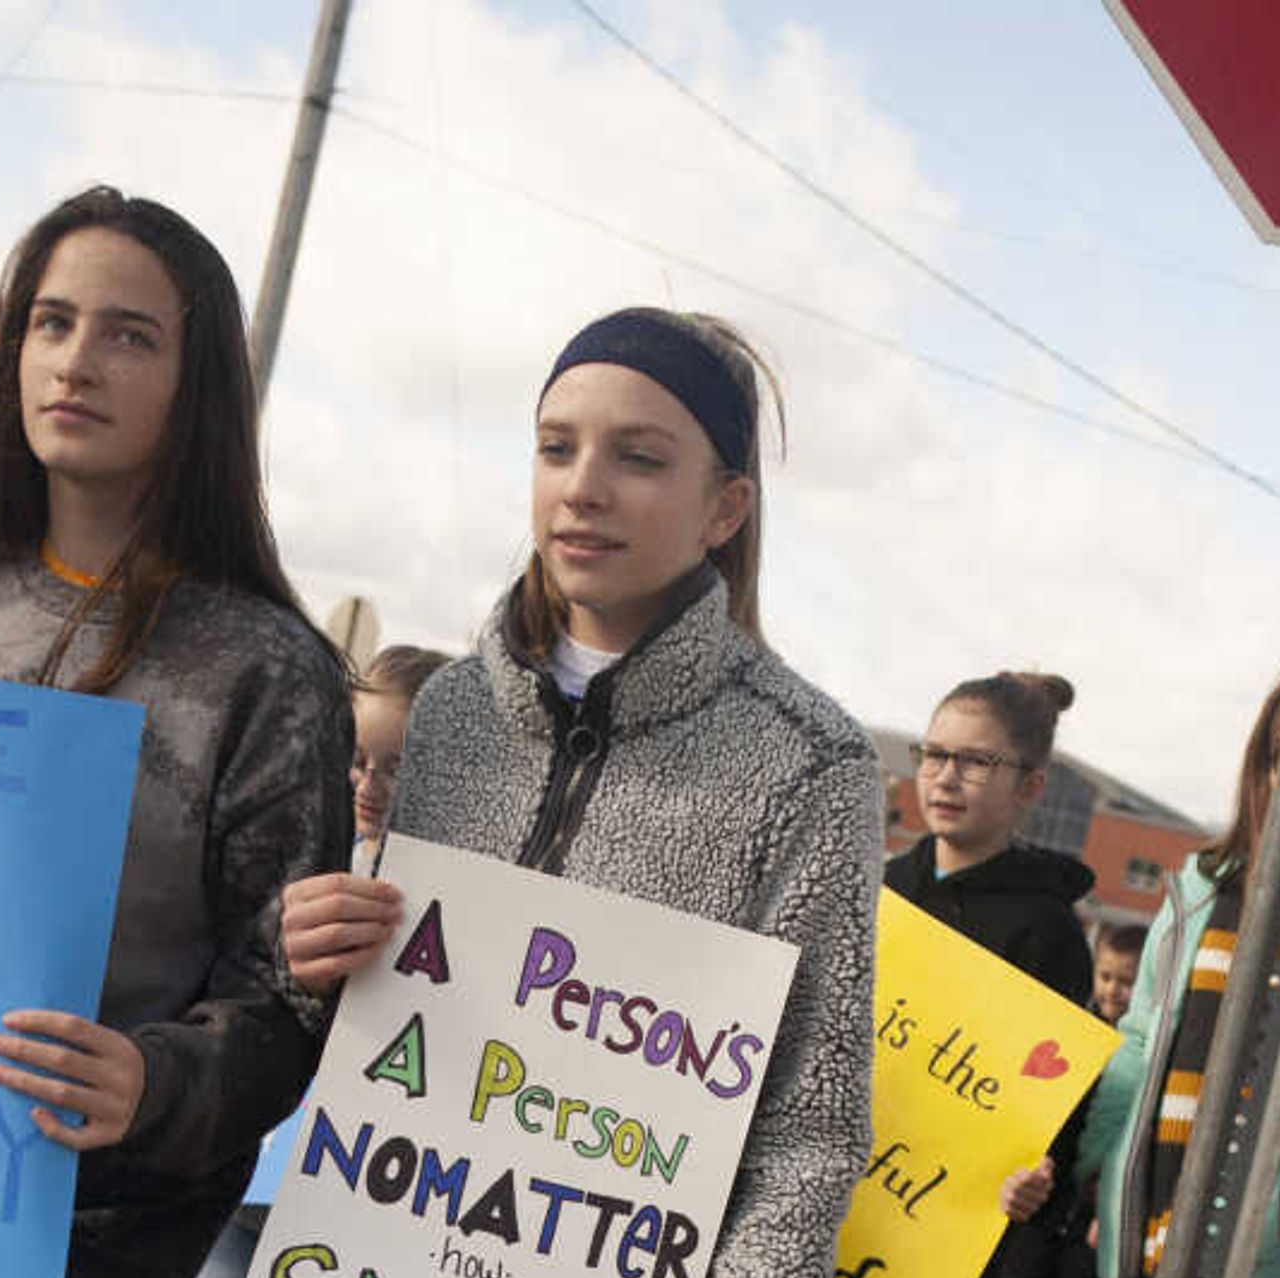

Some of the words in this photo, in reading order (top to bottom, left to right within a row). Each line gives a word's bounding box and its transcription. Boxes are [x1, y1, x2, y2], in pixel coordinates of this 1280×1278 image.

[394, 899, 449, 984] A
[365, 1012, 427, 1098] A
[876, 998, 916, 1049] is
[926, 1027, 1002, 1111] the
